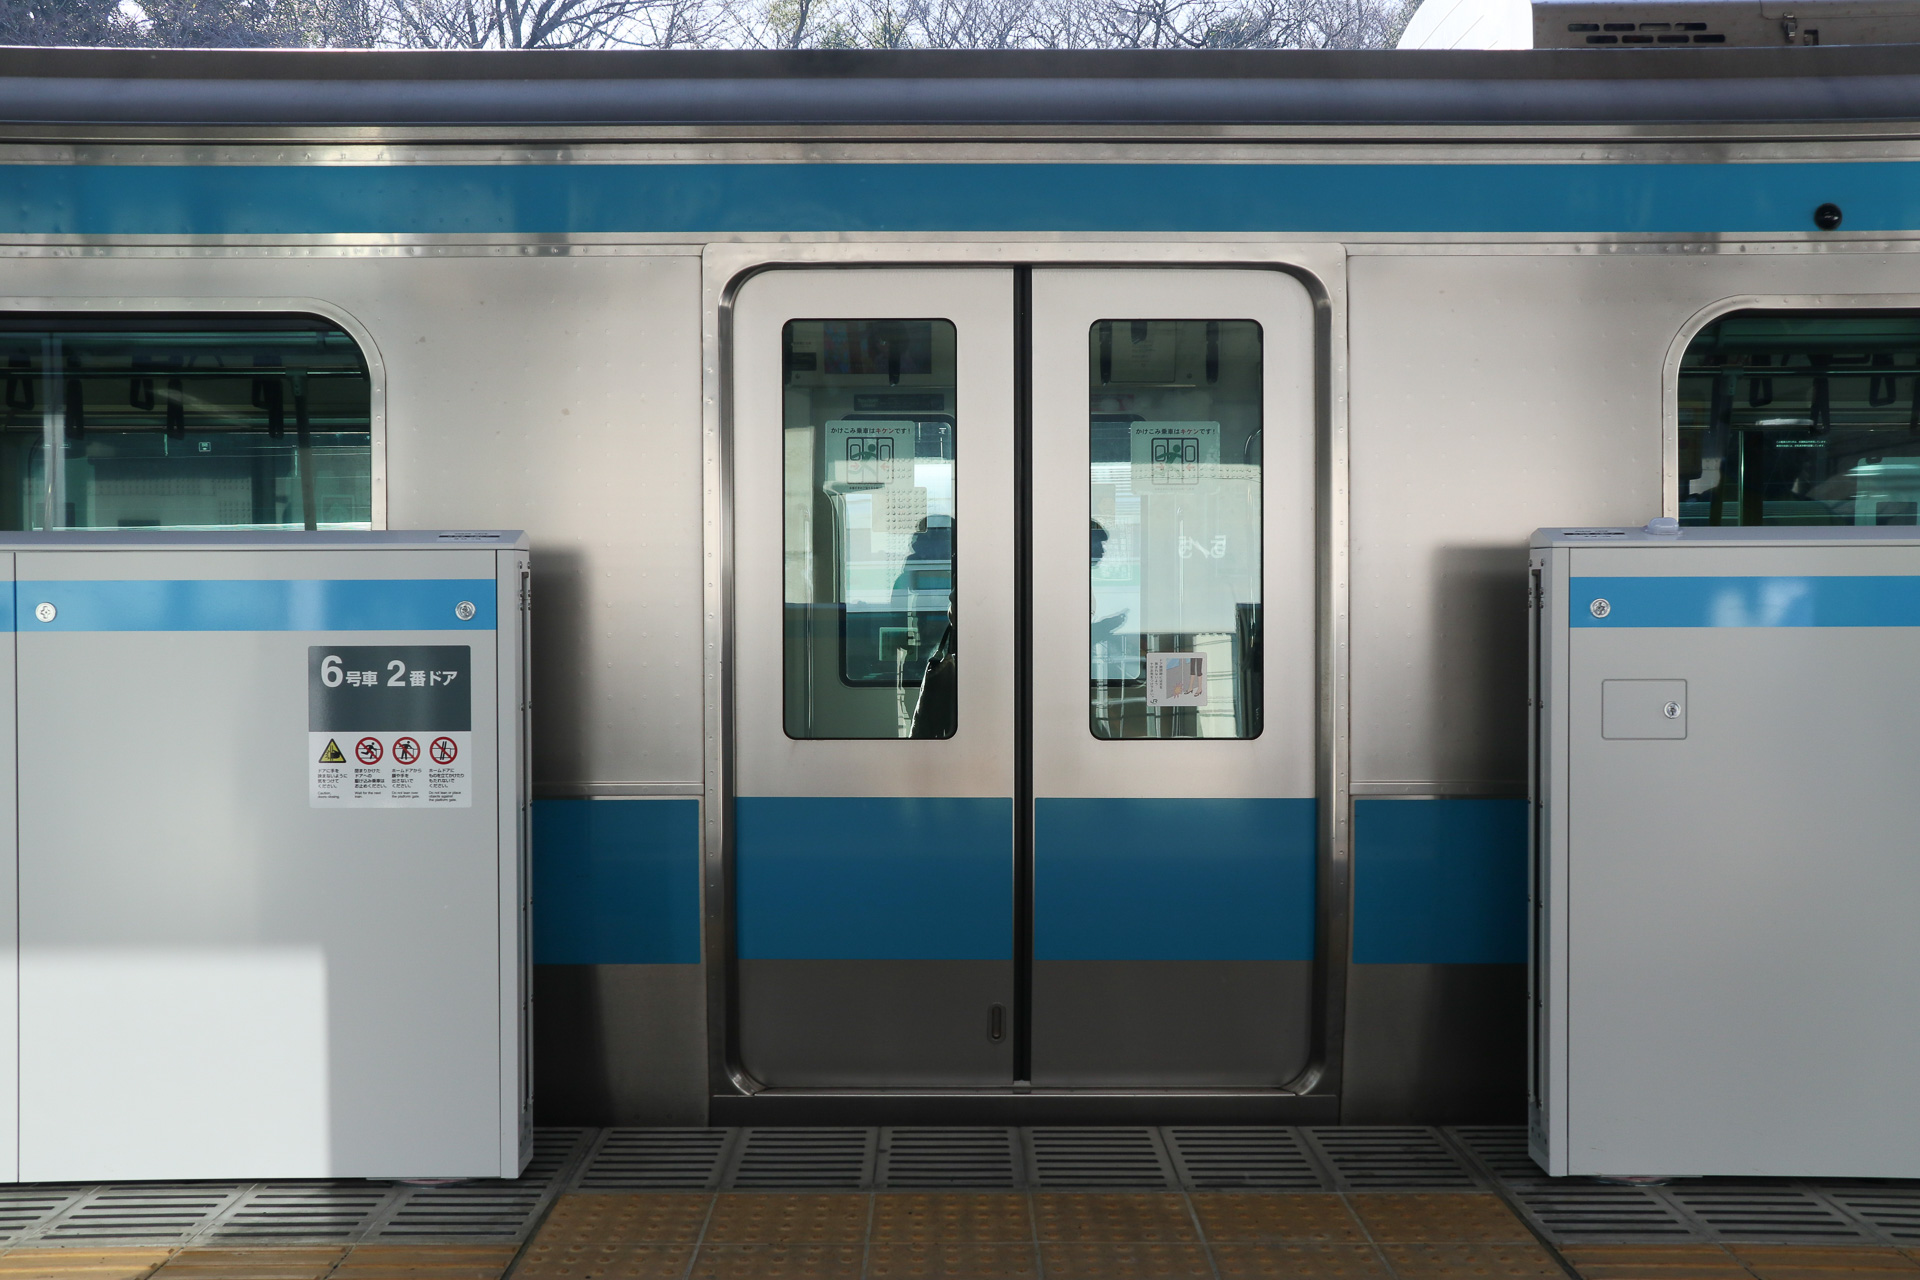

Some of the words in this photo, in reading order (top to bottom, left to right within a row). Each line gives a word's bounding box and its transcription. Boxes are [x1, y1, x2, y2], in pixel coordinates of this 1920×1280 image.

[320, 654, 378, 688] 6号車
[386, 660, 458, 687] 2番ドア
